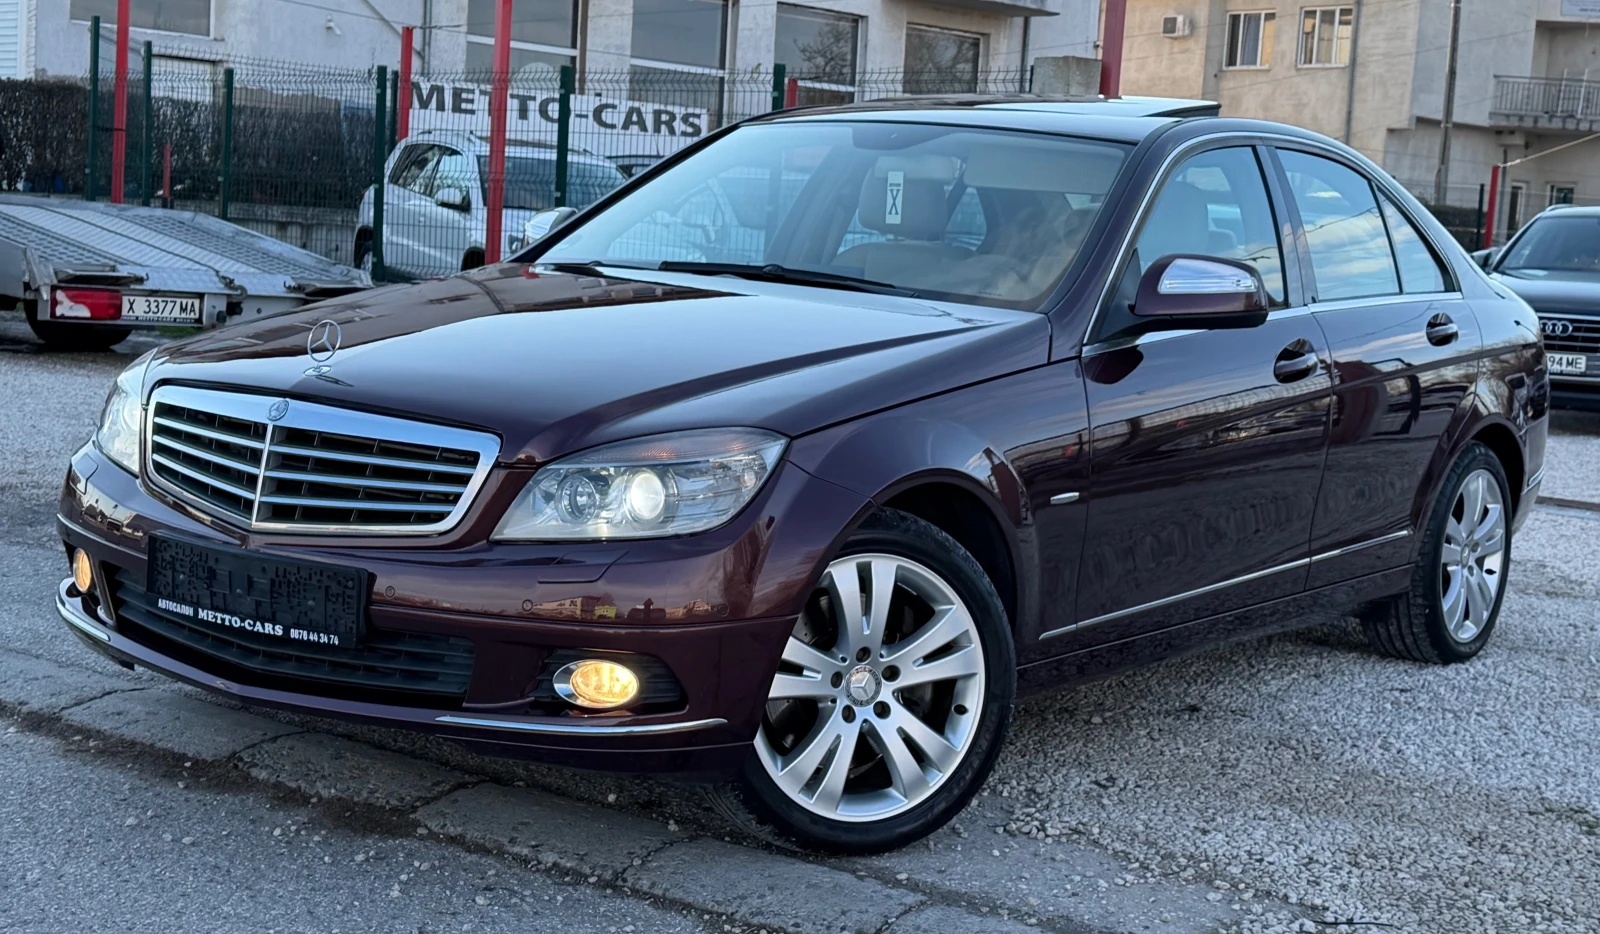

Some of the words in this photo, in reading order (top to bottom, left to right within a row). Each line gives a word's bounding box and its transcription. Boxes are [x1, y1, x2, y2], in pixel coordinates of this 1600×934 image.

[127, 298, 135, 314] X
[143, 298, 177, 315] 3377
[179, 301, 196, 316] MA
[1565, 357, 1583, 370] ME
[158, 598, 194, 617] АВТОСАЛОН
[198, 608, 284, 636] METTO-CARS
[290, 628, 308, 641] 0876
[309, 632, 318, 643] 44
[320, 633, 329, 645] 34
[330, 635, 339, 646] 74
